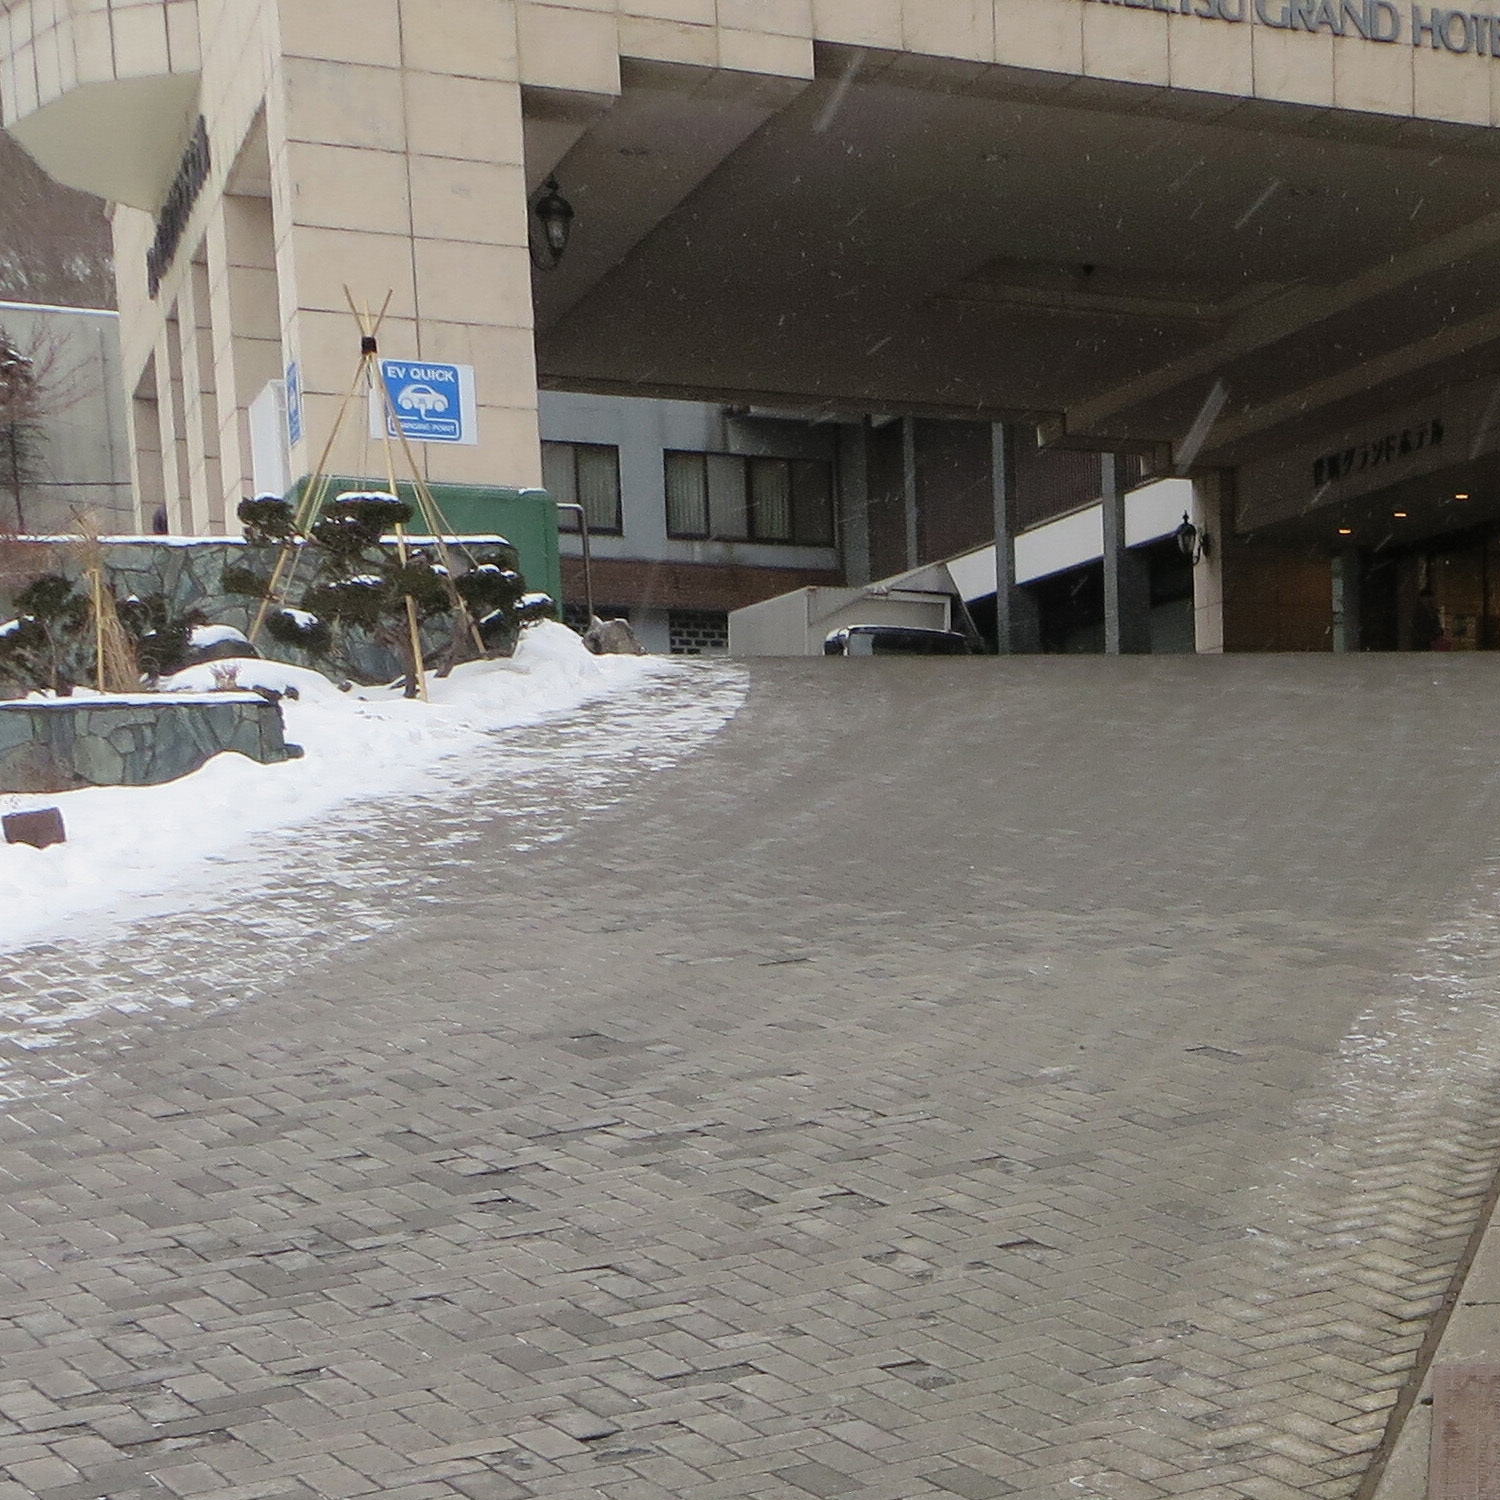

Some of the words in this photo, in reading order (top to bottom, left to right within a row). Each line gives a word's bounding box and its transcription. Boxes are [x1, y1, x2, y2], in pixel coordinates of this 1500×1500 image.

[1255, 0, 1400, 43] GRAND
[387, 366, 406, 379] EV
[410, 368, 455, 383] QUICK
